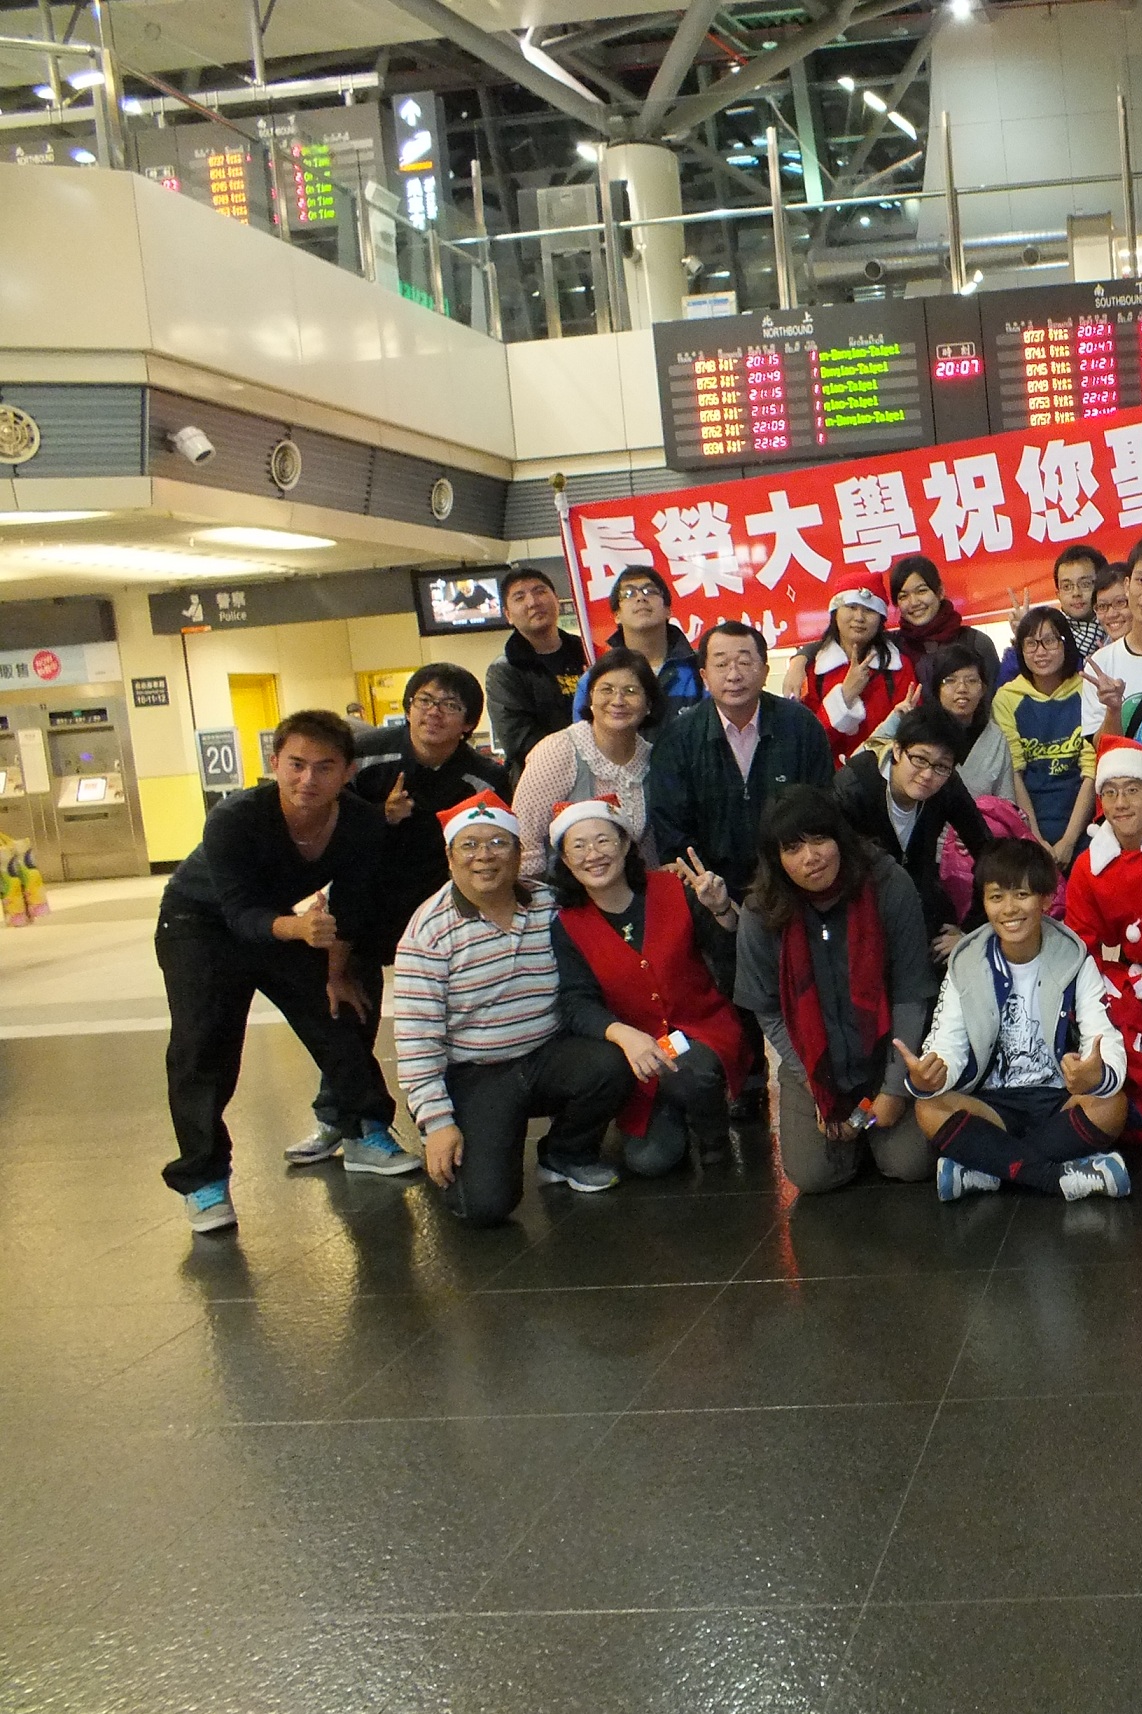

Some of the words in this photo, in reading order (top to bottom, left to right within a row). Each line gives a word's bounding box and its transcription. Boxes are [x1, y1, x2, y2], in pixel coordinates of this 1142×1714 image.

[763, 323, 814, 338] NORTHBOUND
[1023, 330, 1045, 343] 0737
[1078, 324, 1111, 338] 20:21
[1025, 346, 1046, 360] 0741
[1079, 341, 1113, 354] 20:47
[746, 354, 780, 368] 20:15
[936, 359, 979, 377] 20:07
[1026, 363, 1048, 376] 0745
[1080, 357, 1114, 370] 21:21
[697, 377, 718, 390] 0752
[748, 370, 781, 384] 20:49
[1027, 379, 1049, 393] 0749
[1081, 374, 1115, 387] 21:45
[749, 387, 783, 400] 21:15
[1029, 396, 1051, 410] 0753
[1083, 391, 1117, 404] 22:21
[751, 404, 784, 416] 21:51
[753, 419, 786, 433] 22:09
[754, 436, 787, 449] 22:25
[219, 610, 247, 622] Police
[206, 745, 234, 774] 20
